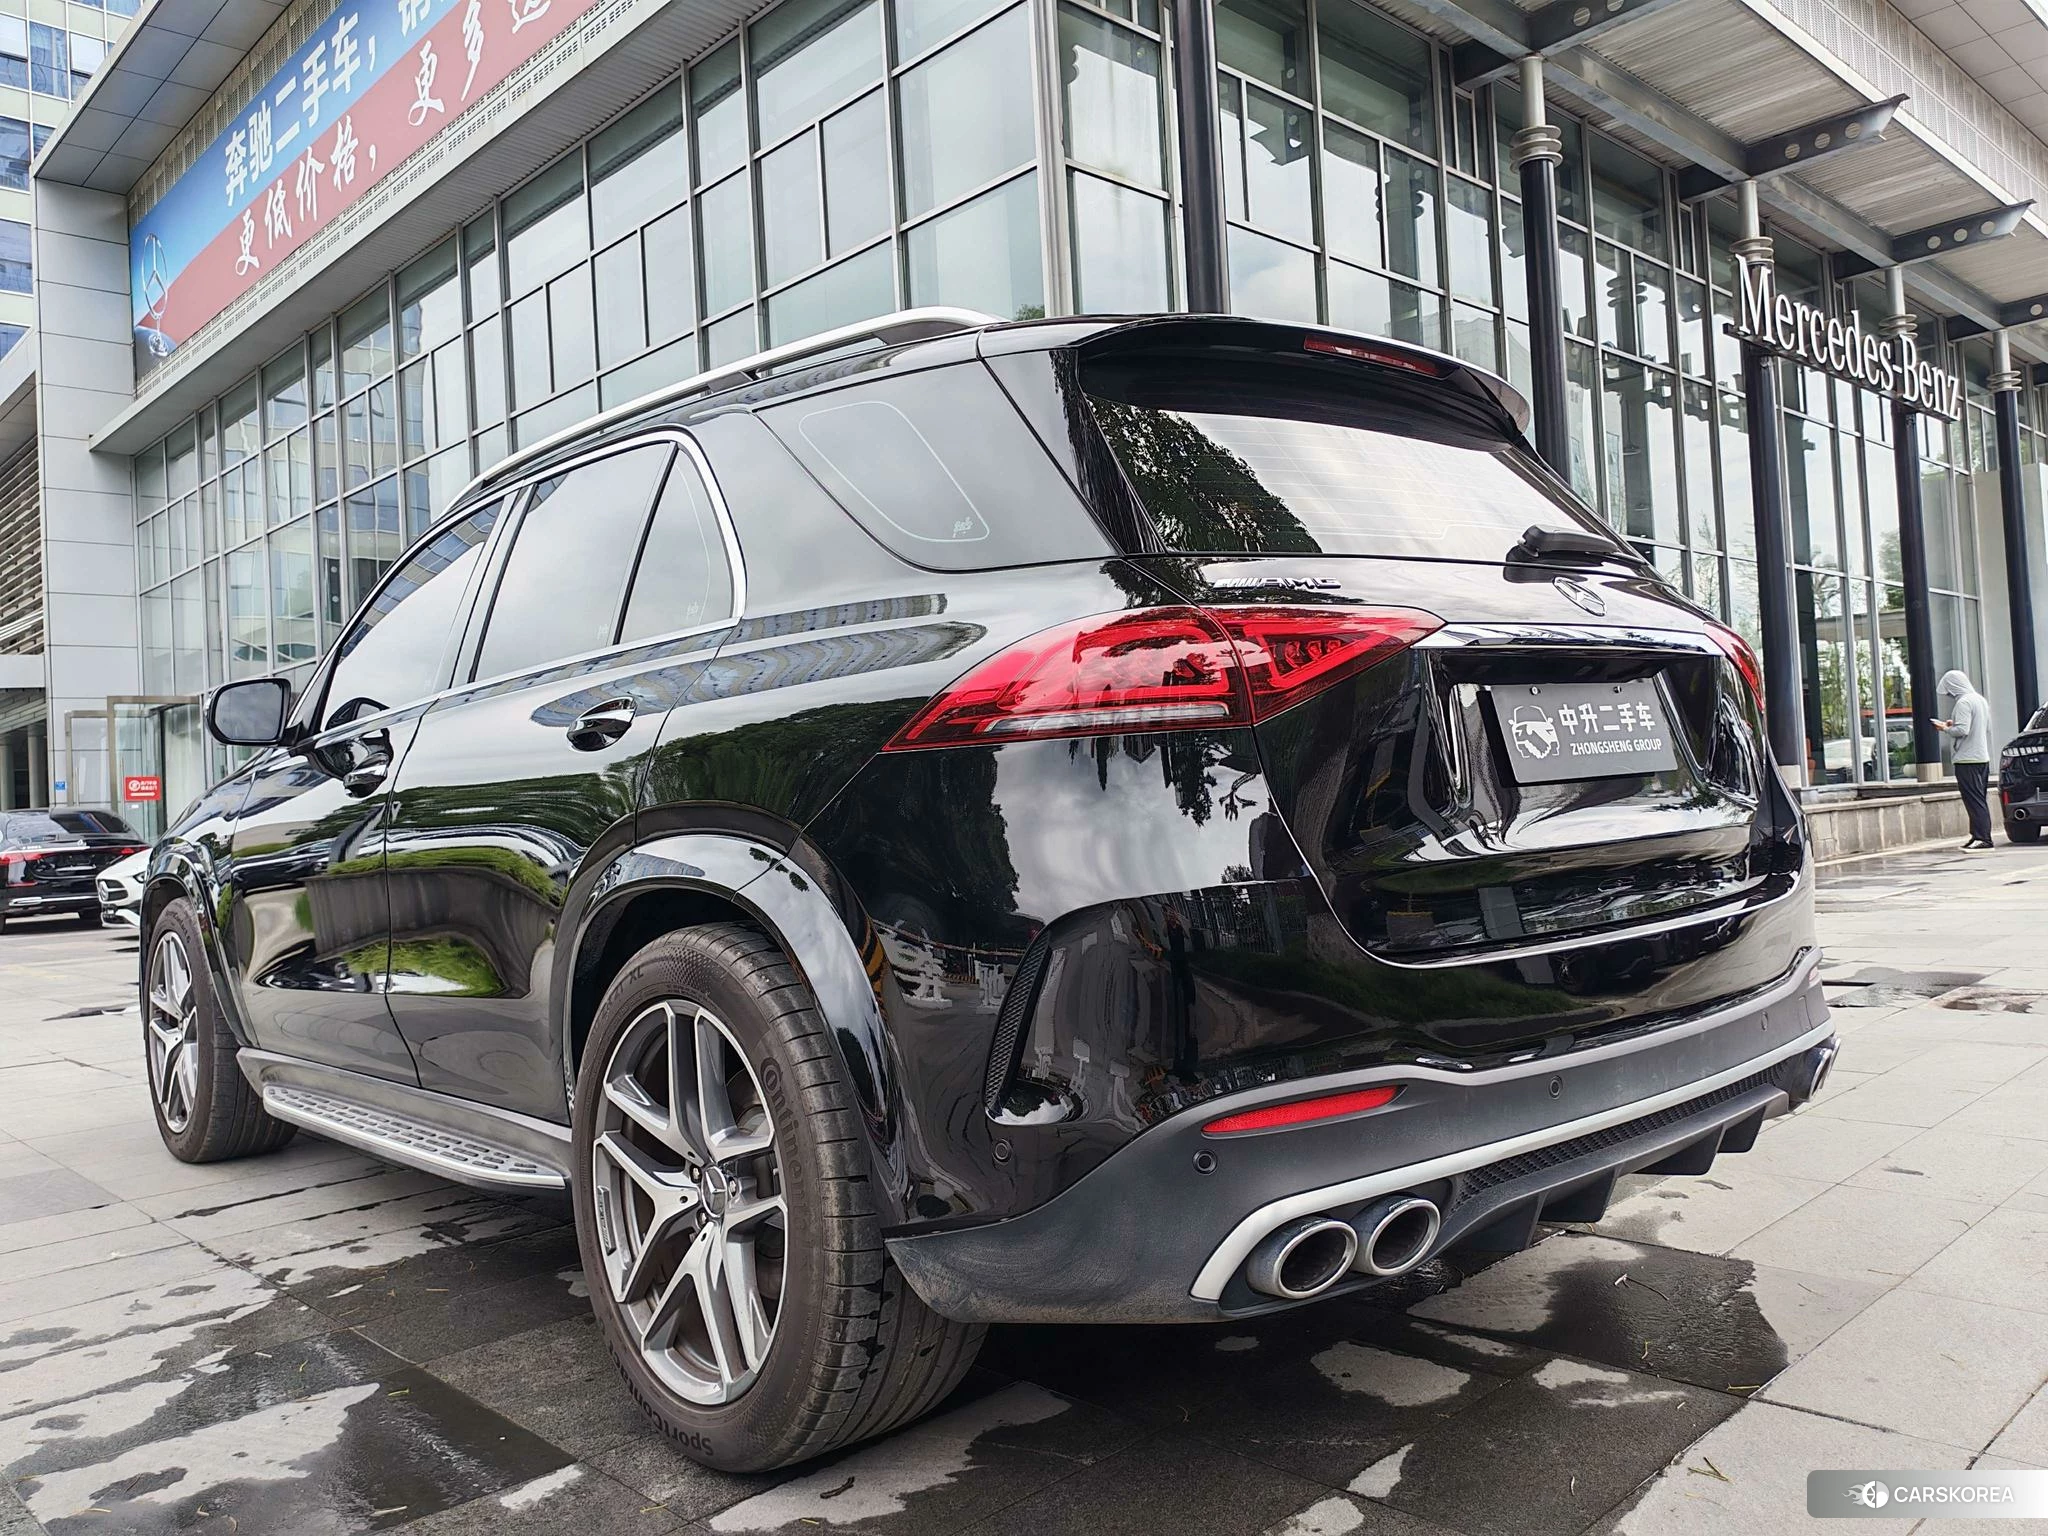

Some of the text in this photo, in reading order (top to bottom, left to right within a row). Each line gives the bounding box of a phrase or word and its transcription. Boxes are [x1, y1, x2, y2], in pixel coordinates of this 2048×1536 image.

[1735, 254, 1961, 422] Mercedes-Benz
[1256, 577, 1342, 589] AMG
[1558, 702, 1656, 735] 中升二手车
[1569, 738, 1663, 756] ZHONGSHENG GROUP
